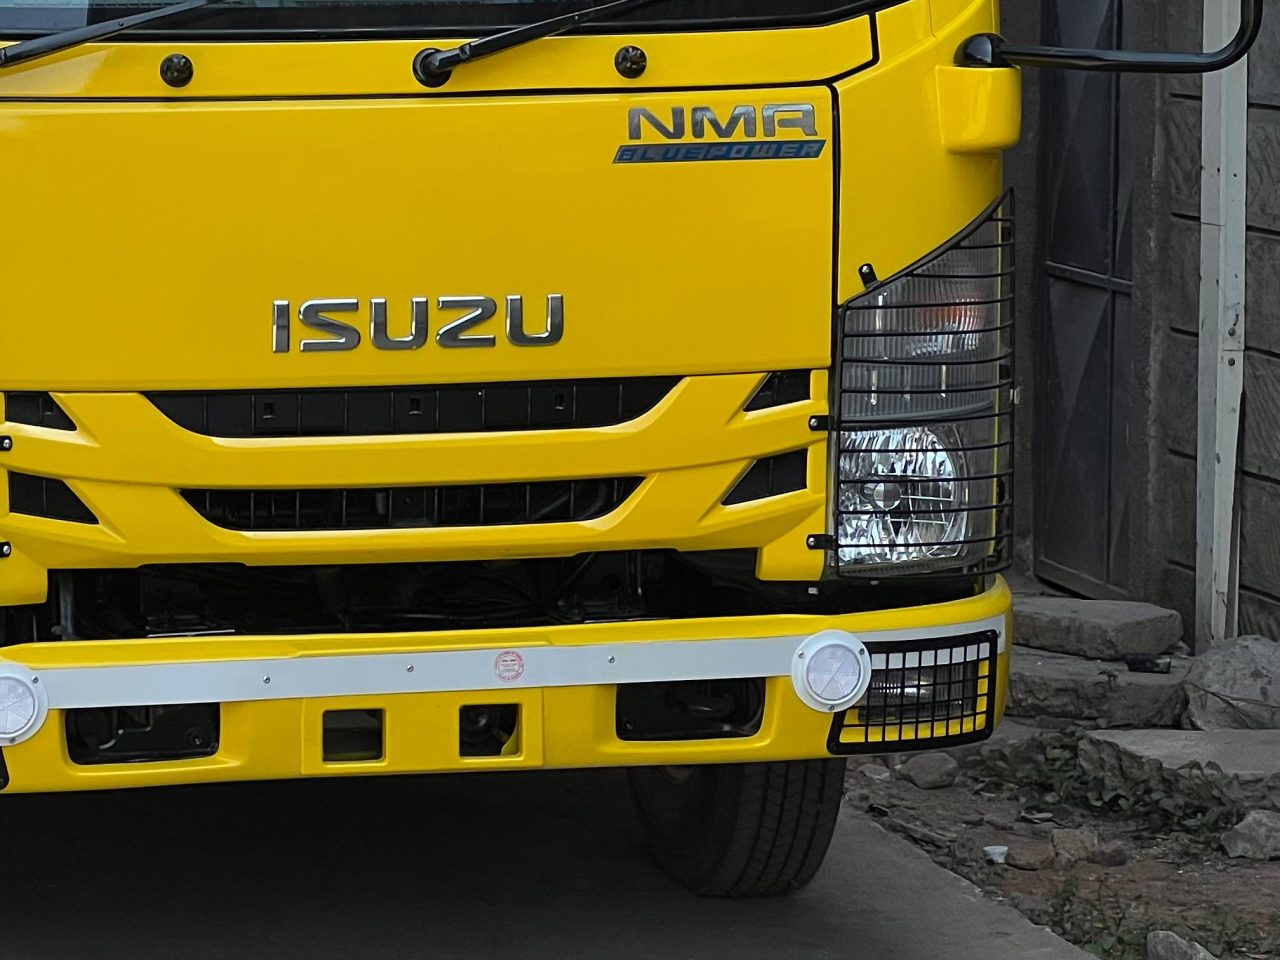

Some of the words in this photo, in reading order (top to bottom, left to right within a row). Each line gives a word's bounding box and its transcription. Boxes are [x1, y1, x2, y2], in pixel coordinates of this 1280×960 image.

[627, 103, 819, 140] NMR
[619, 141, 823, 162] BLUEPOWER
[273, 294, 564, 354] ISUZU
